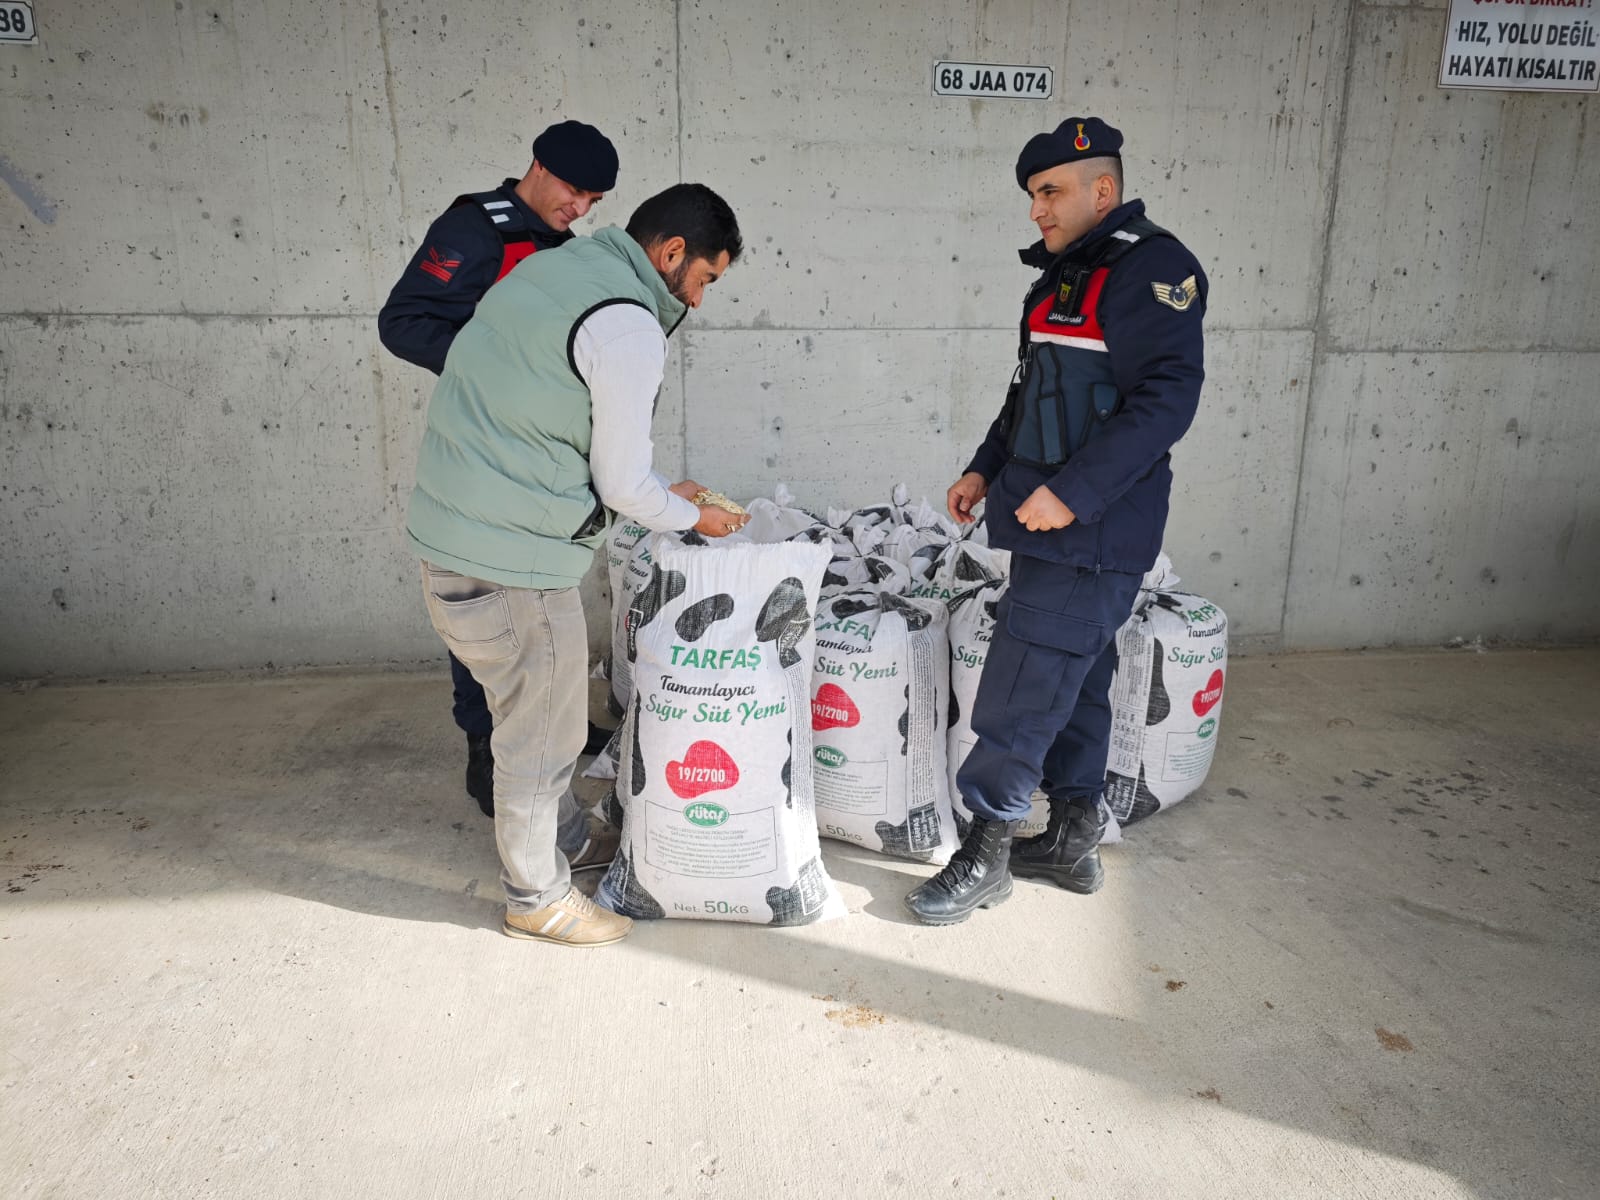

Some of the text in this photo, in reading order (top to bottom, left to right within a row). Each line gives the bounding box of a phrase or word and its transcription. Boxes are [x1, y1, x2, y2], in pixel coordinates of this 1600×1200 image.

[1458, 20, 1597, 47] HIZ, YOLU DEĞİL
[1448, 55, 1597, 81] HAYATI KISALTIR
[941, 69, 1047, 93] 68 JAA 074
[671, 645, 761, 671] TARFAŞ
[814, 656, 898, 682] Süt Yemi
[954, 645, 984, 669] Sığı
[1168, 647, 1206, 668] Sığır
[660, 675, 757, 701] Tamamlayıcı
[645, 694, 787, 726] Sığır Süt Yemi
[812, 703, 849, 722] 19/2700
[678, 766, 726, 783] 19/2700
[704, 900, 749, 914] 50KG
